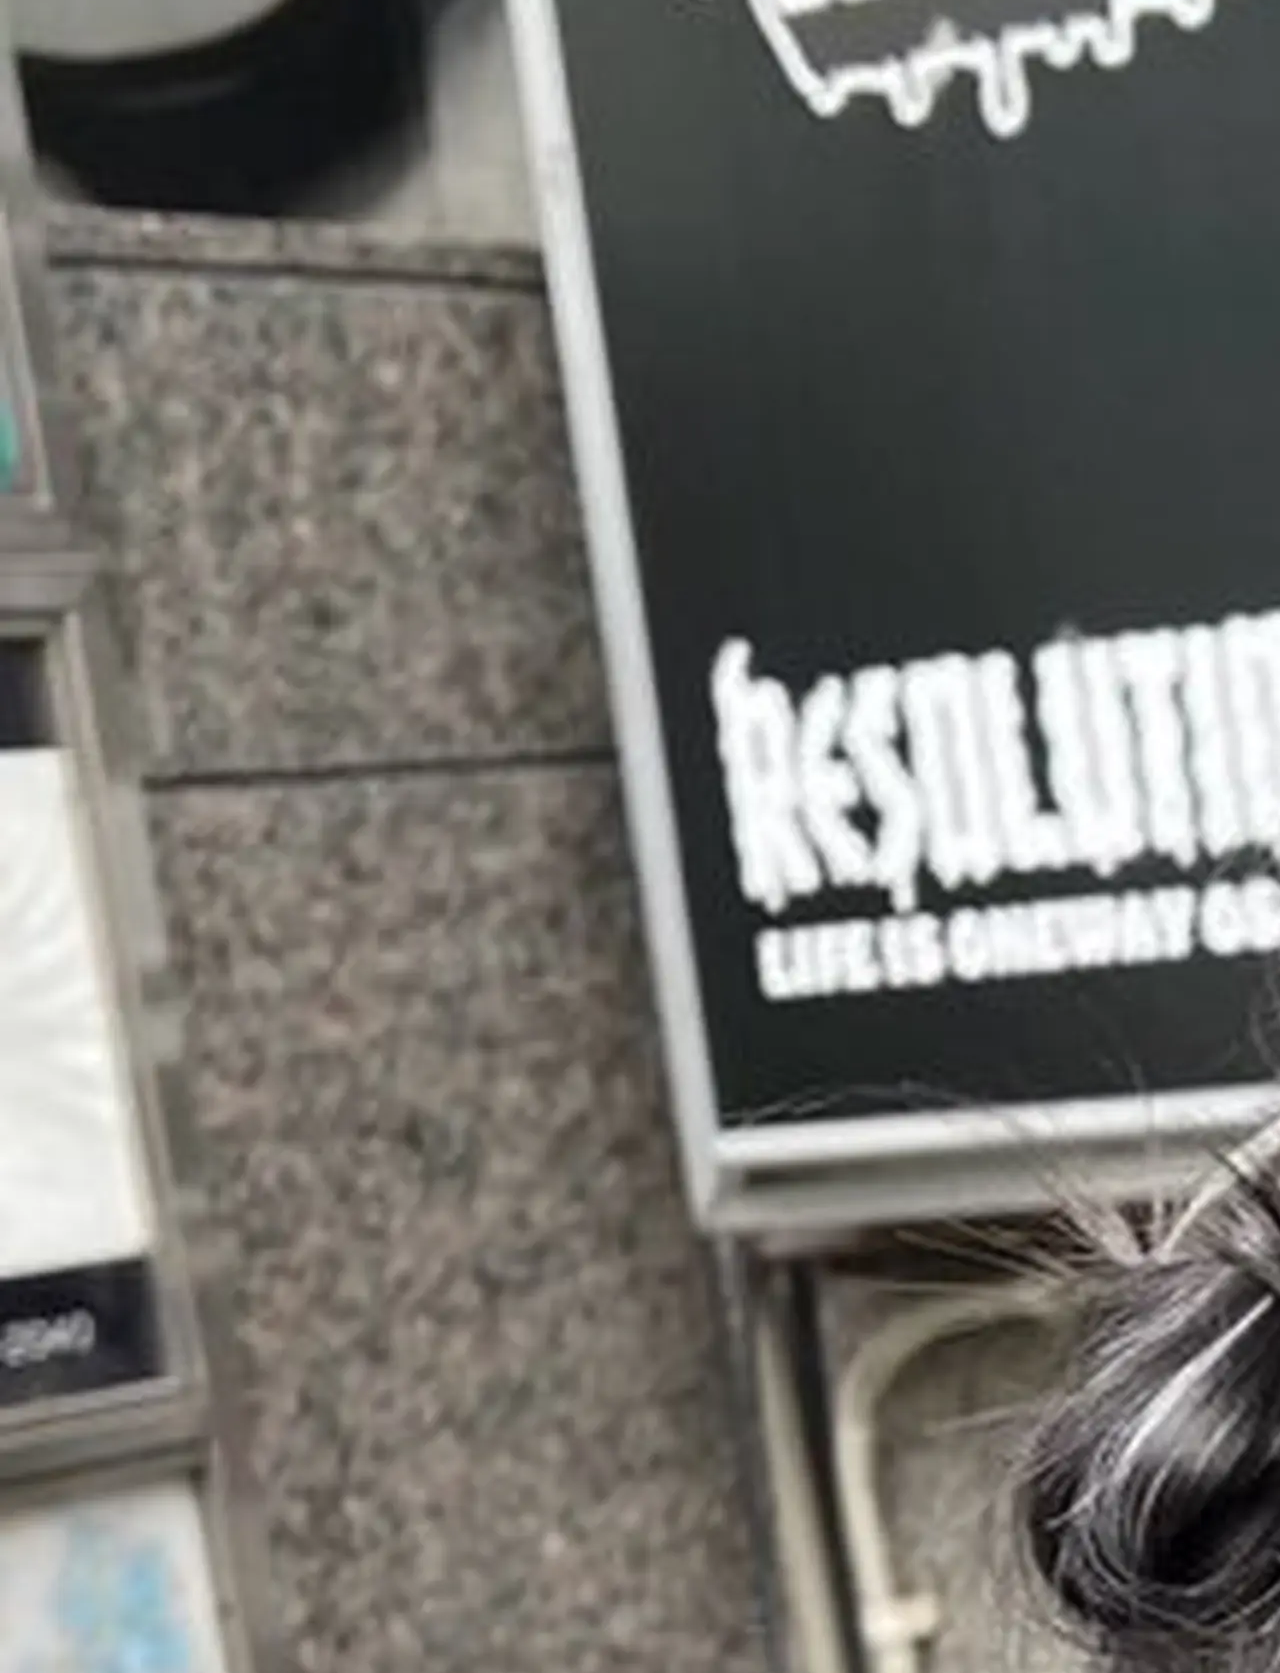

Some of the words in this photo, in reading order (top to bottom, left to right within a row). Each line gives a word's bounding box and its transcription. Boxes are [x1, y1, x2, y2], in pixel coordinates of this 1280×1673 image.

[756, 918, 880, 1000] LIFE
[880, 912, 945, 985] IS
[946, 886, 1197, 981] ONEWAY
